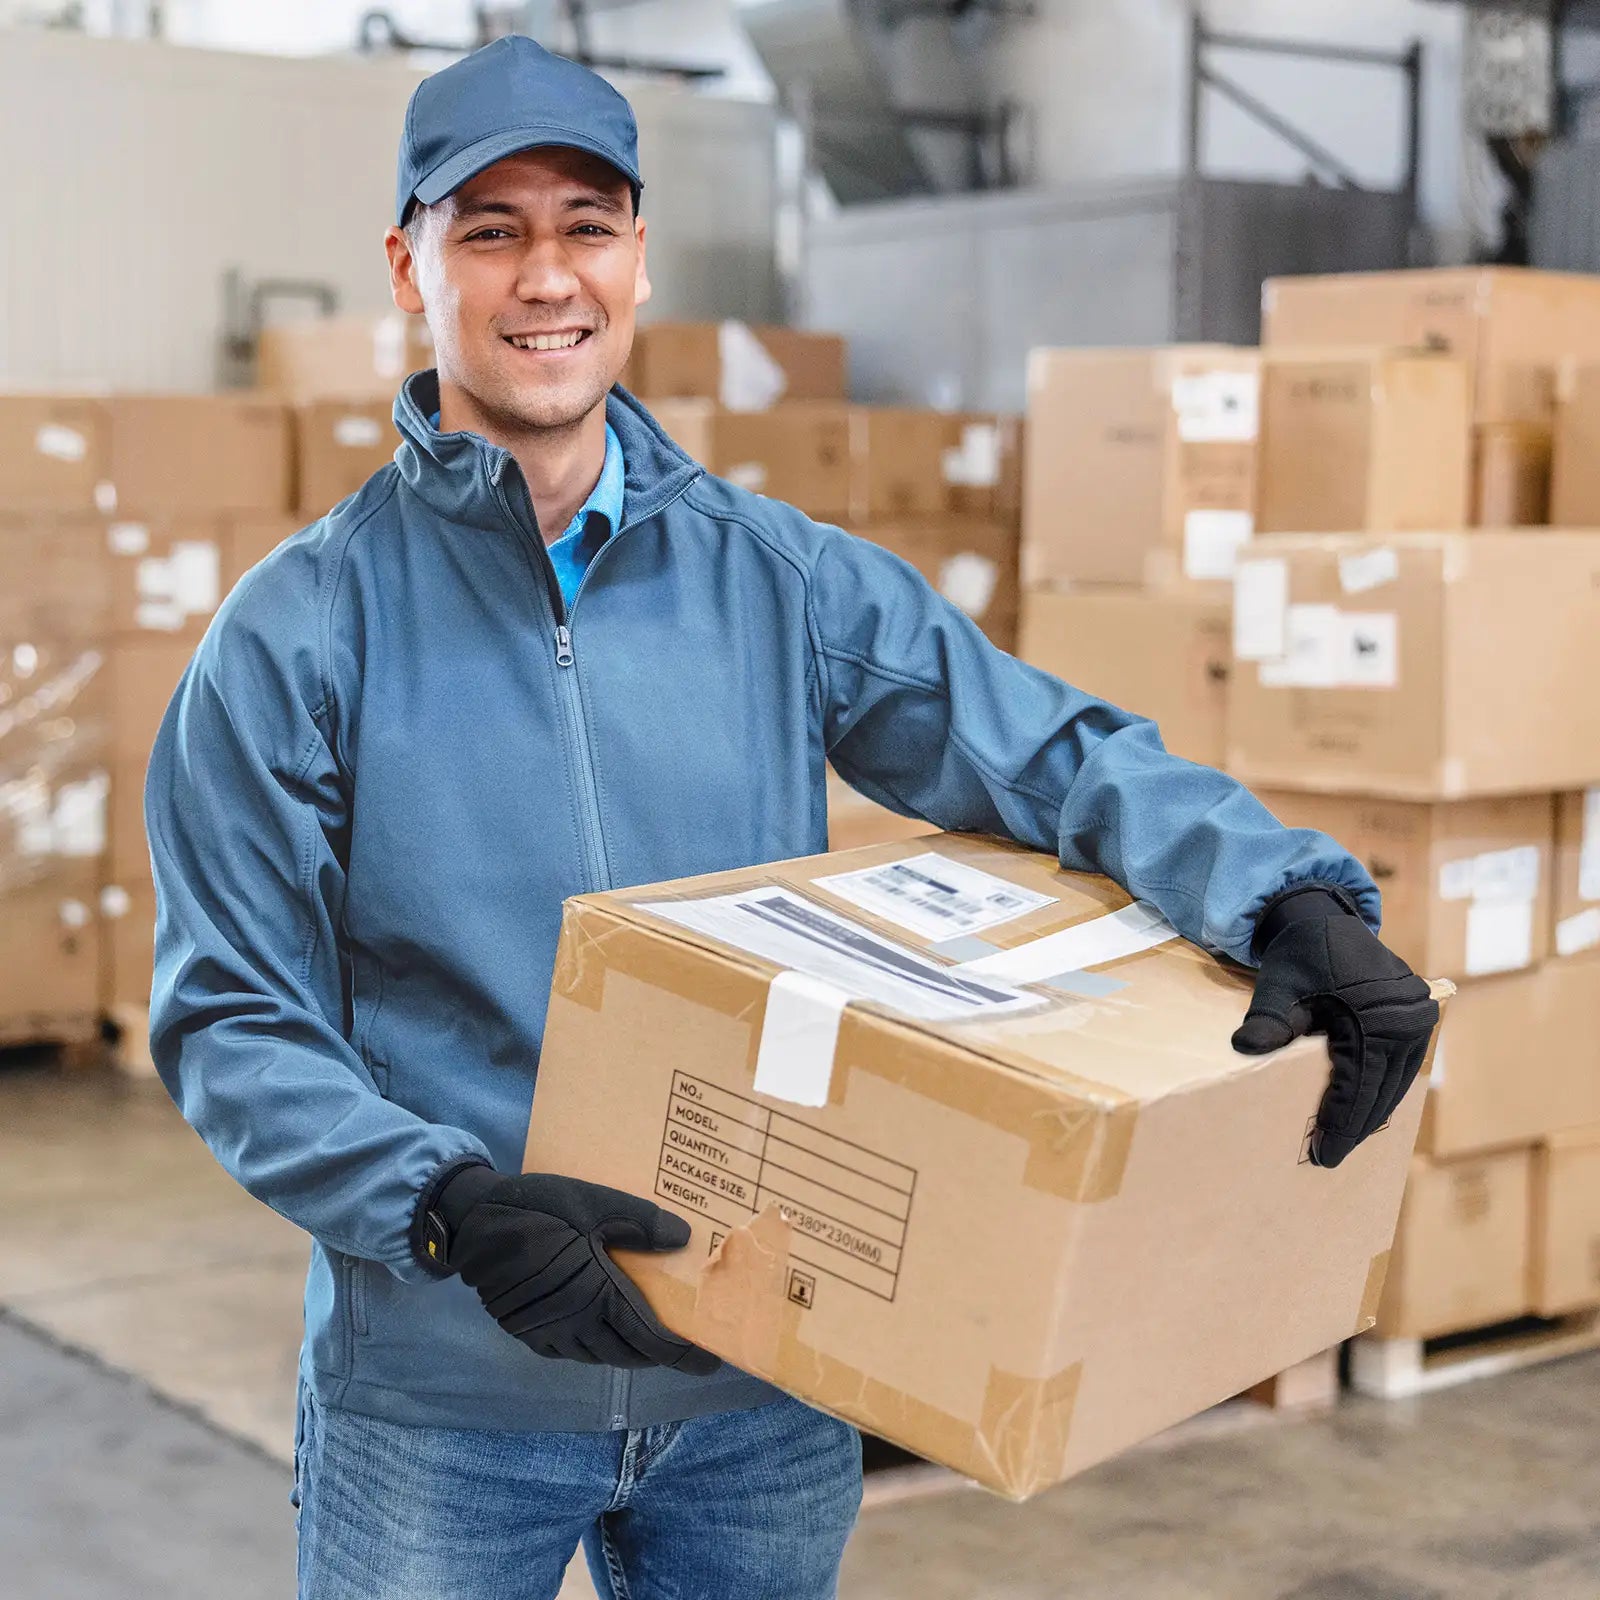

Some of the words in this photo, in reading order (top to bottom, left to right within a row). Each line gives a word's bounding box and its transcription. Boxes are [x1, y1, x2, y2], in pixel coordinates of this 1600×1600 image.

[675, 1106, 719, 1132] MODEL:
[669, 1130, 729, 1164] QUANTITY:
[665, 1154, 718, 1187] PACKAGE
[719, 1177, 746, 1199] SIZE:
[662, 1179, 709, 1209] WEIGHT:
